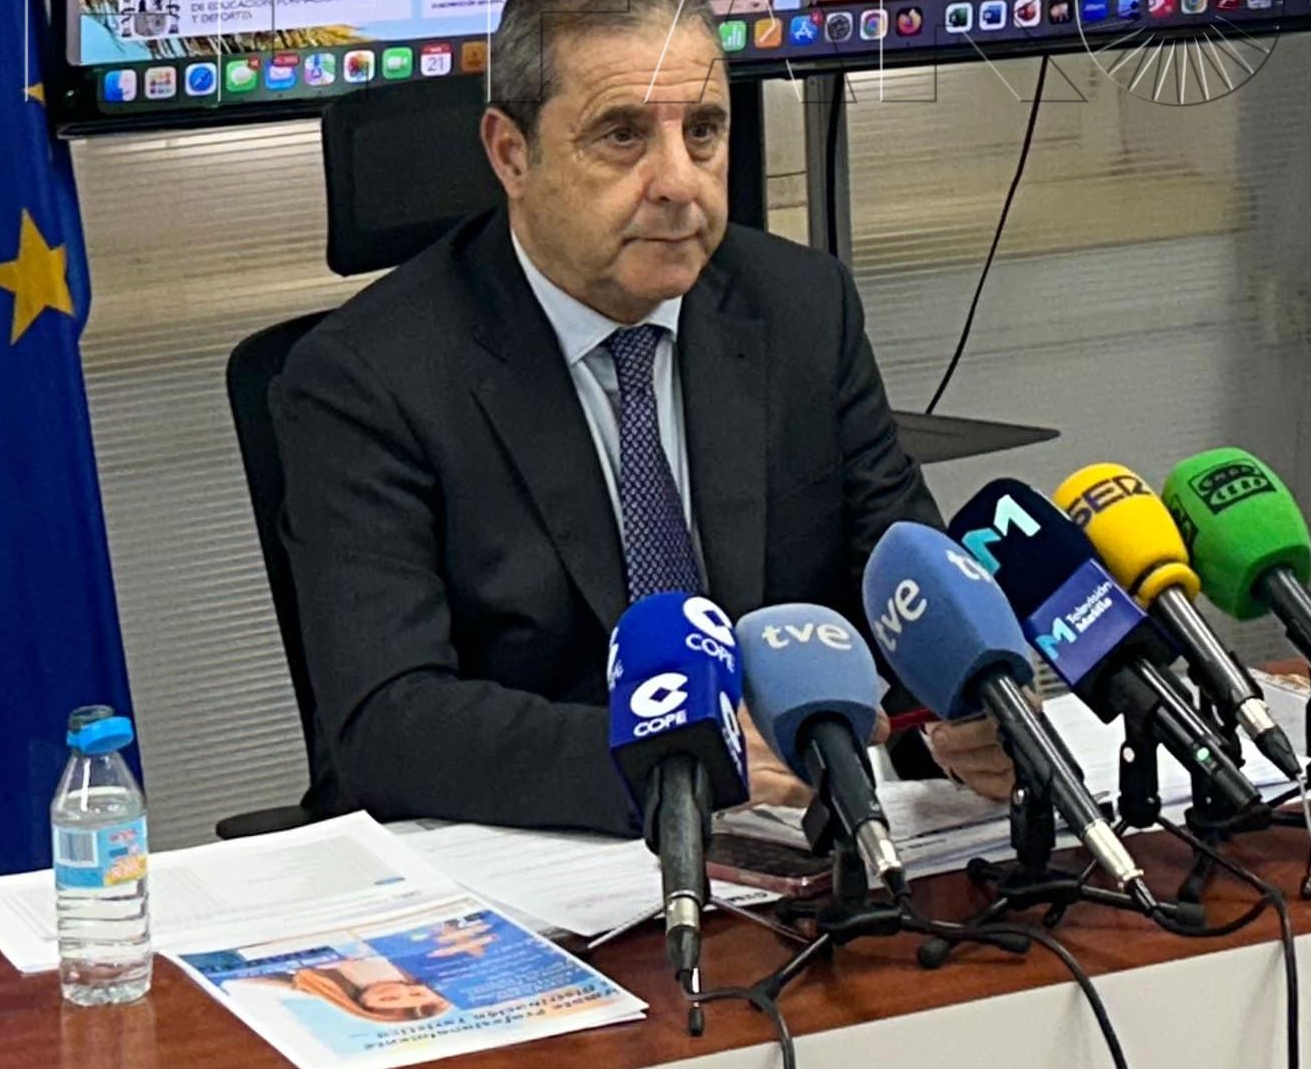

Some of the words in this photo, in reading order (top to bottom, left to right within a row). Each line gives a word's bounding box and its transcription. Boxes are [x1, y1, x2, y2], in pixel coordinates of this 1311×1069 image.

[427, 57, 445, 72] 21
[1069, 473, 1152, 526] SER
[872, 578, 928, 652] tve
[761, 622, 852, 649] tve
[685, 633, 735, 673] COPE
[633, 710, 687, 737] COPE
